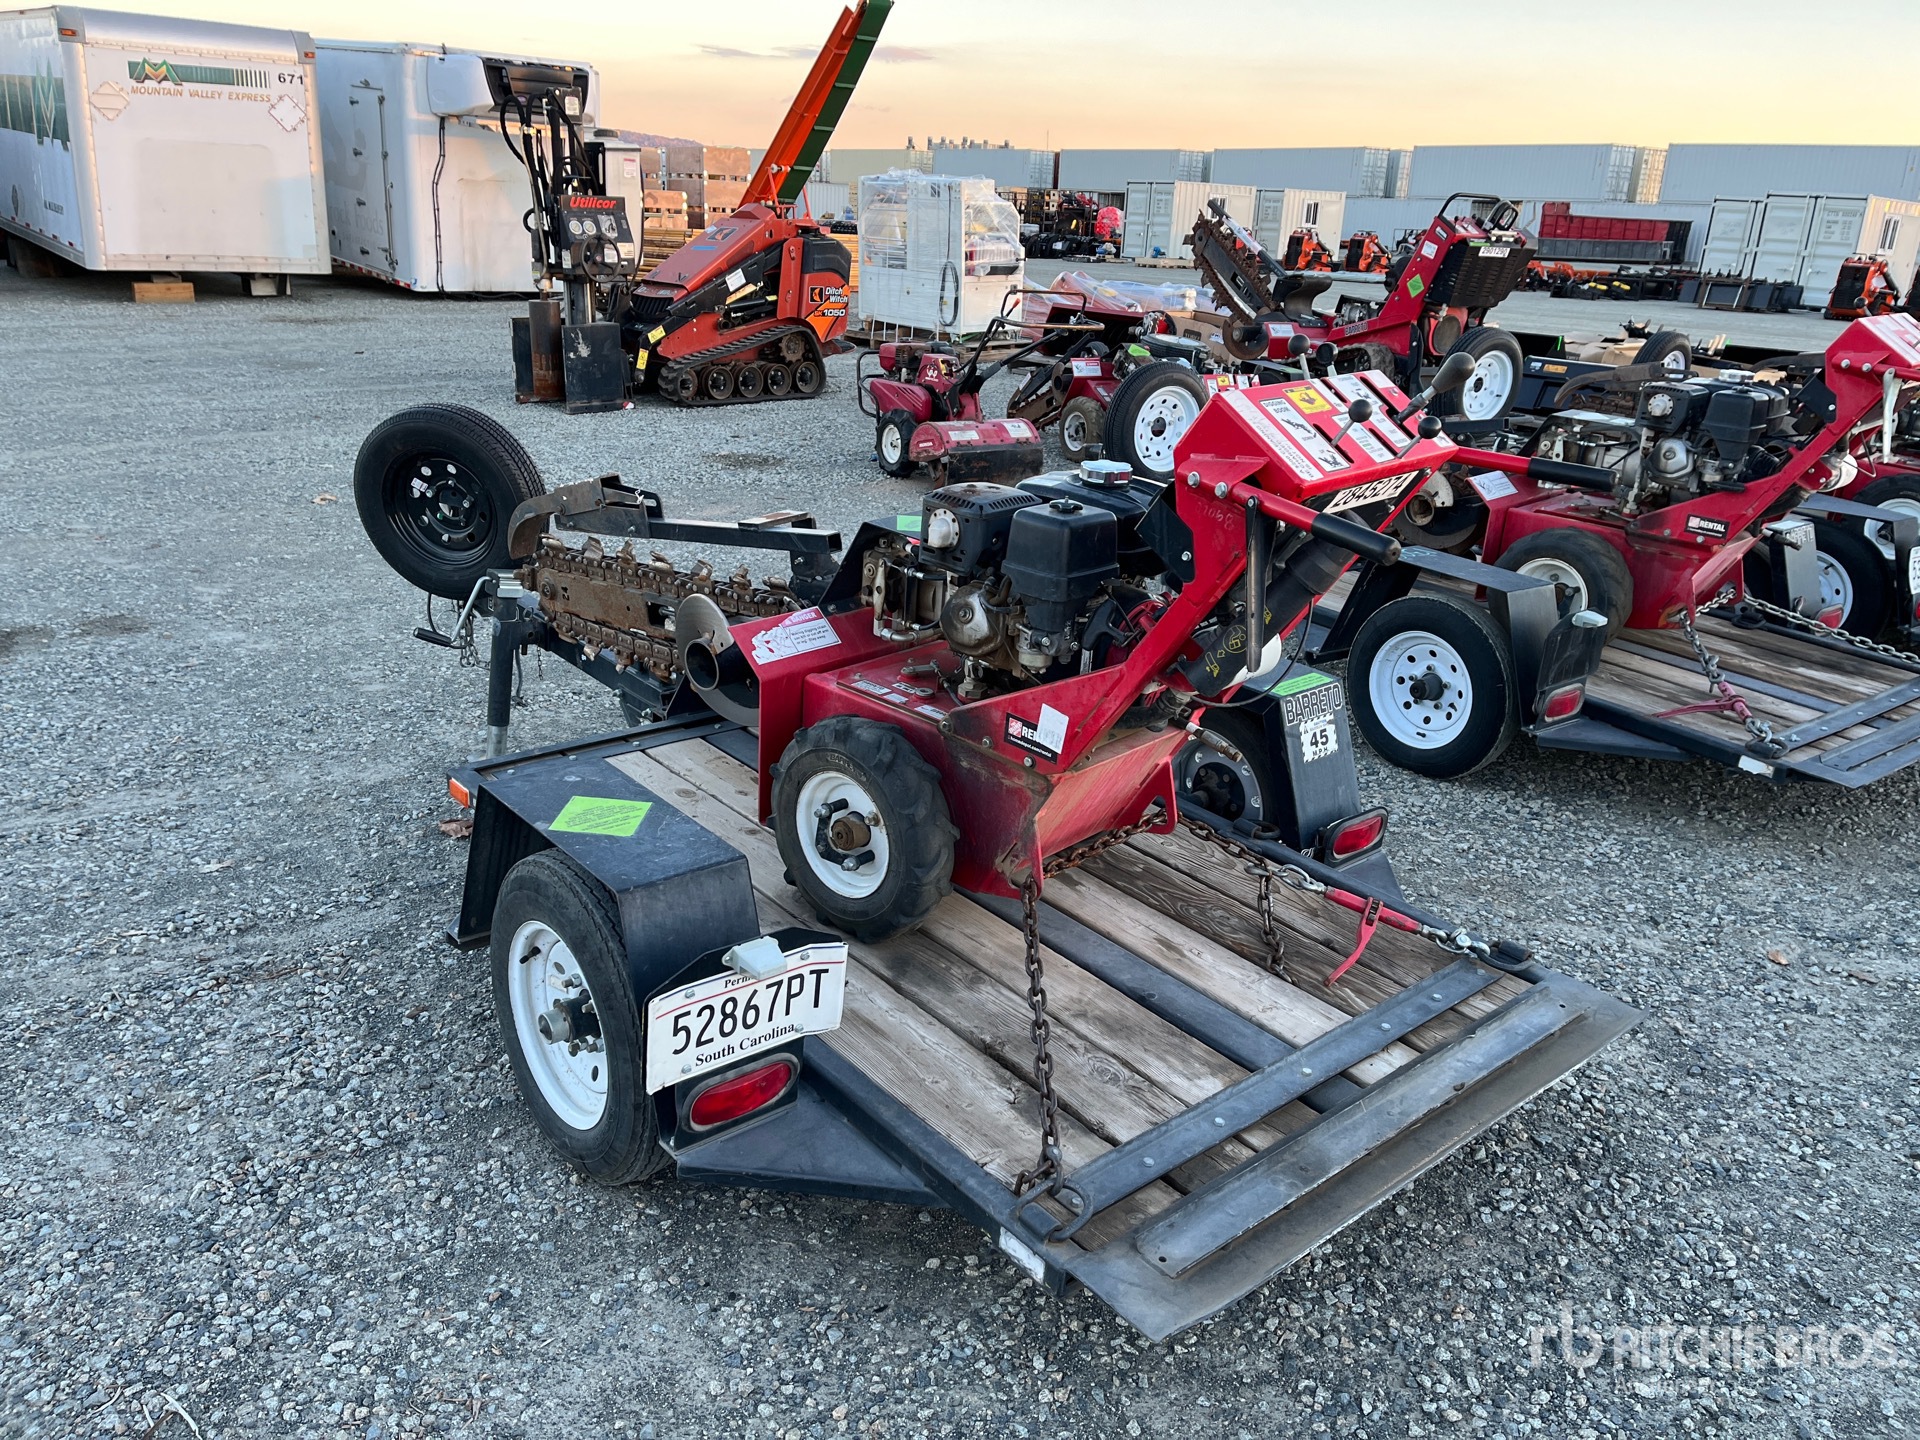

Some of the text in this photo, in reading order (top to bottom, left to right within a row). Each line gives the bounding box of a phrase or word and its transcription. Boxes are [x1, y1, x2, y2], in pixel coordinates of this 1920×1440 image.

[278, 72, 304, 85] 671
[130, 85, 272, 103] MOUNTAIN VALLEY EXPRESS
[569, 196, 617, 209] Utilicor
[825, 287, 843, 295] Ditch
[1330, 472, 1412, 508] 2845274
[1699, 520, 1726, 532] RENTAL
[792, 611, 818, 622] DANGER
[1284, 682, 1343, 726] BARRETO
[1309, 727, 1329, 748] 45
[672, 968, 829, 1056] 52867PT
[695, 1023, 796, 1067] South Carolina
